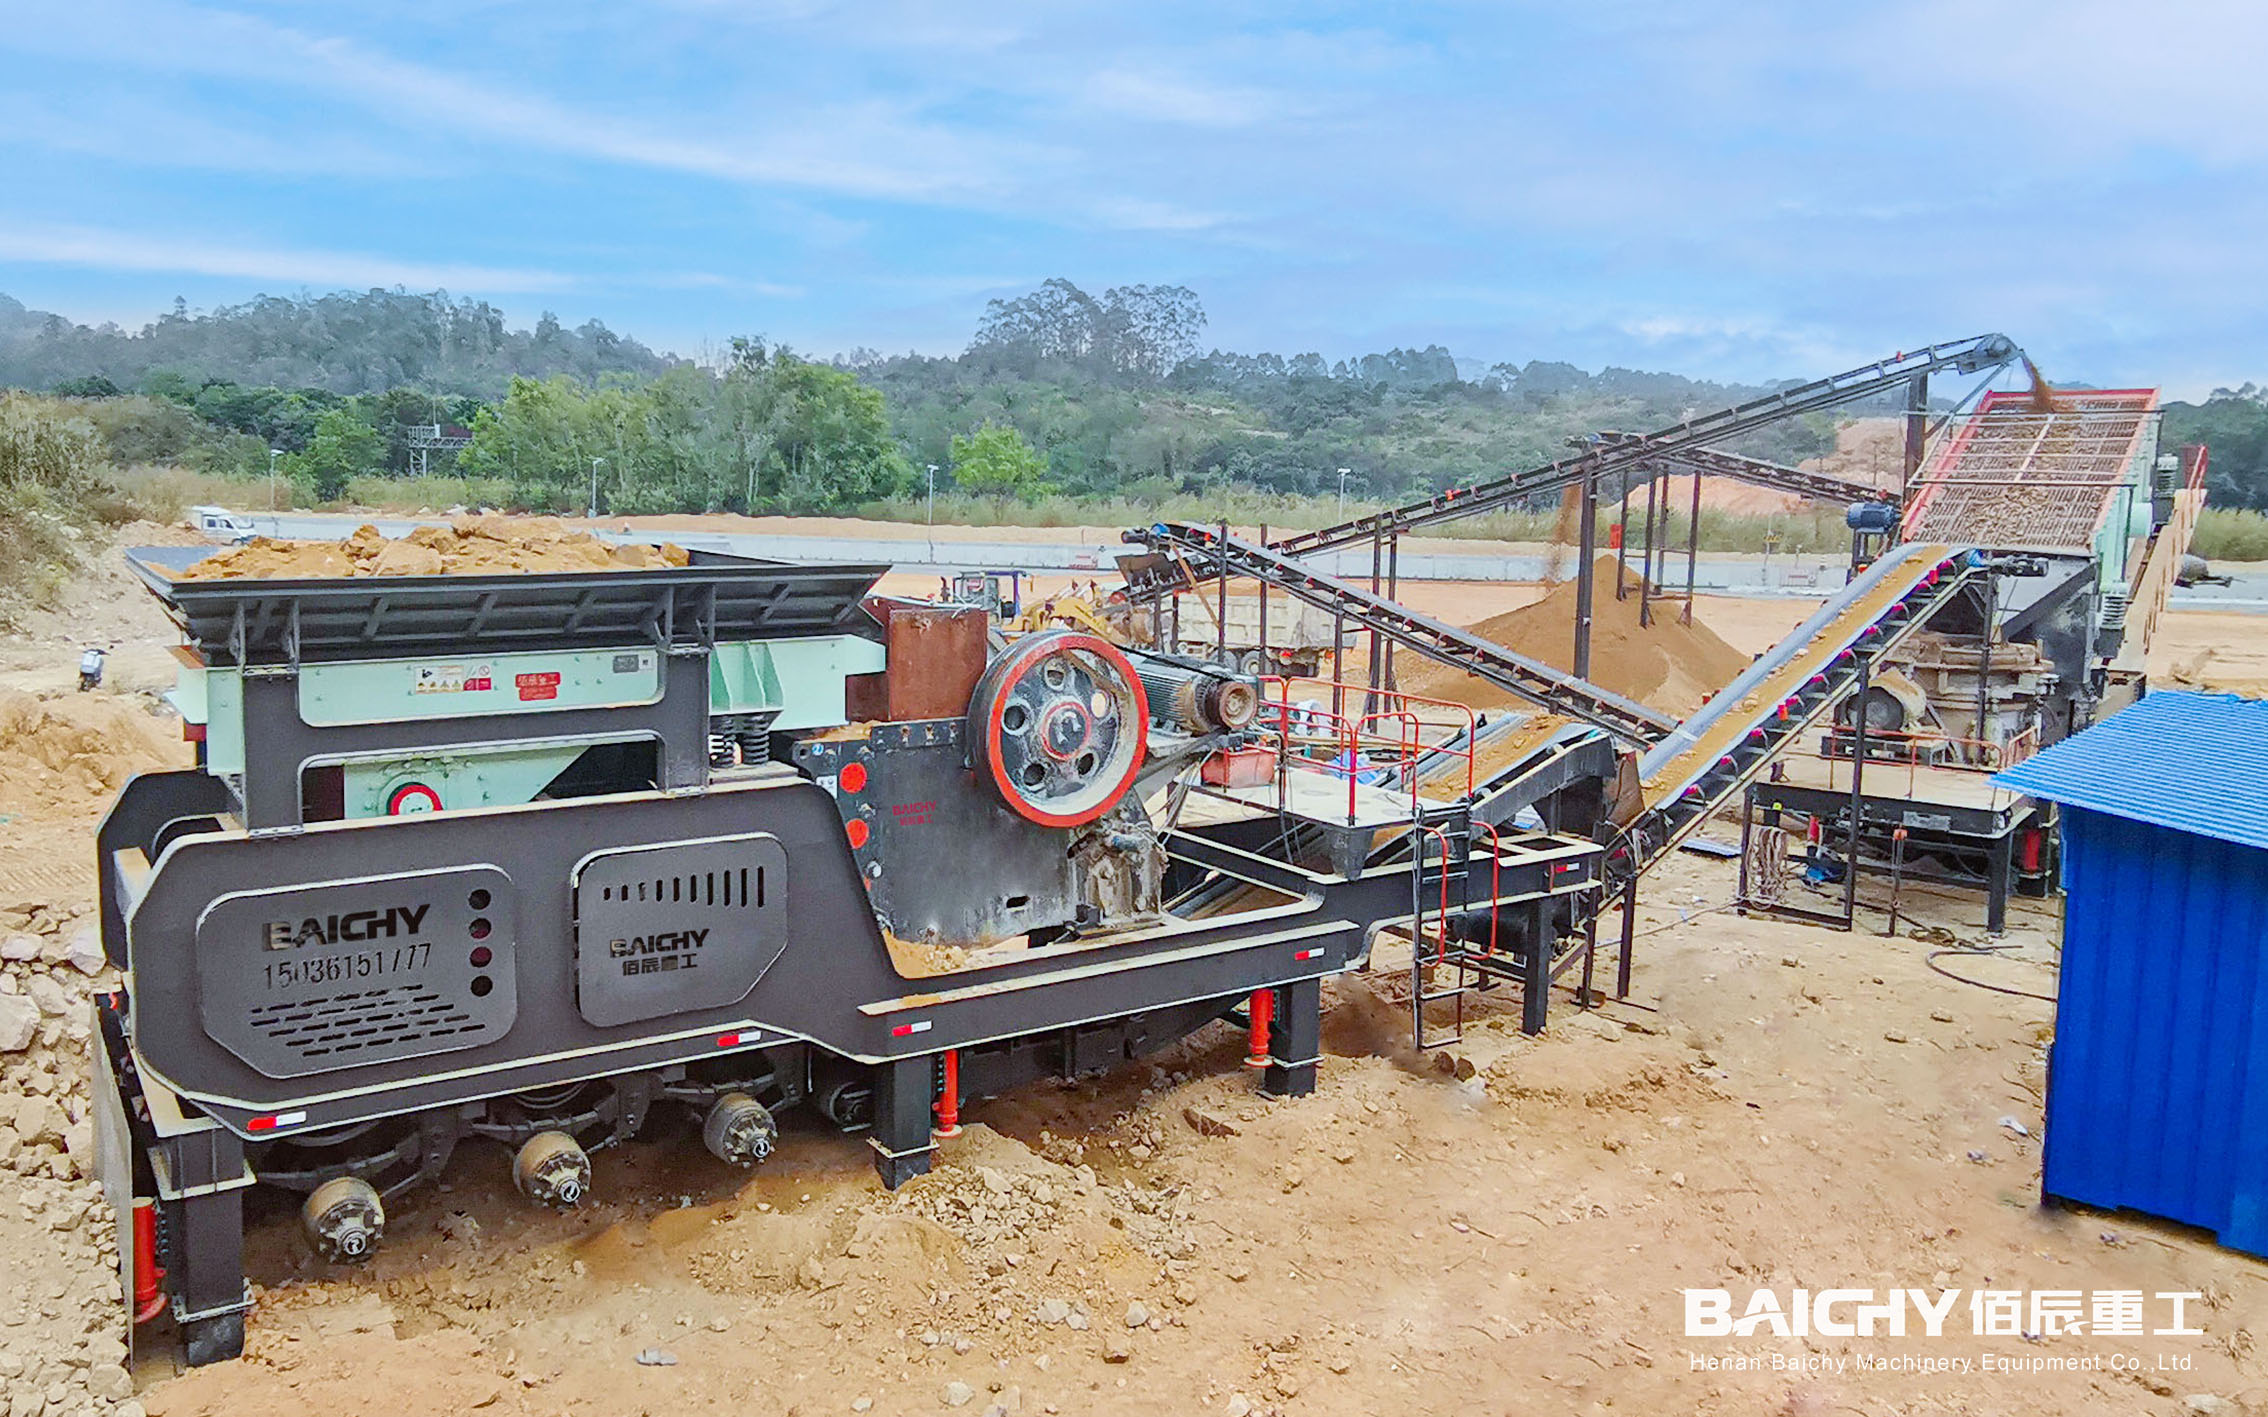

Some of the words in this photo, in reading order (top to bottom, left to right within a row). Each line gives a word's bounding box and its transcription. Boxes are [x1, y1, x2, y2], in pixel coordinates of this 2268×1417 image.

[892, 800, 937, 816] BAICHY
[262, 904, 431, 952] BAICHY
[609, 928, 710, 958] BAICHY
